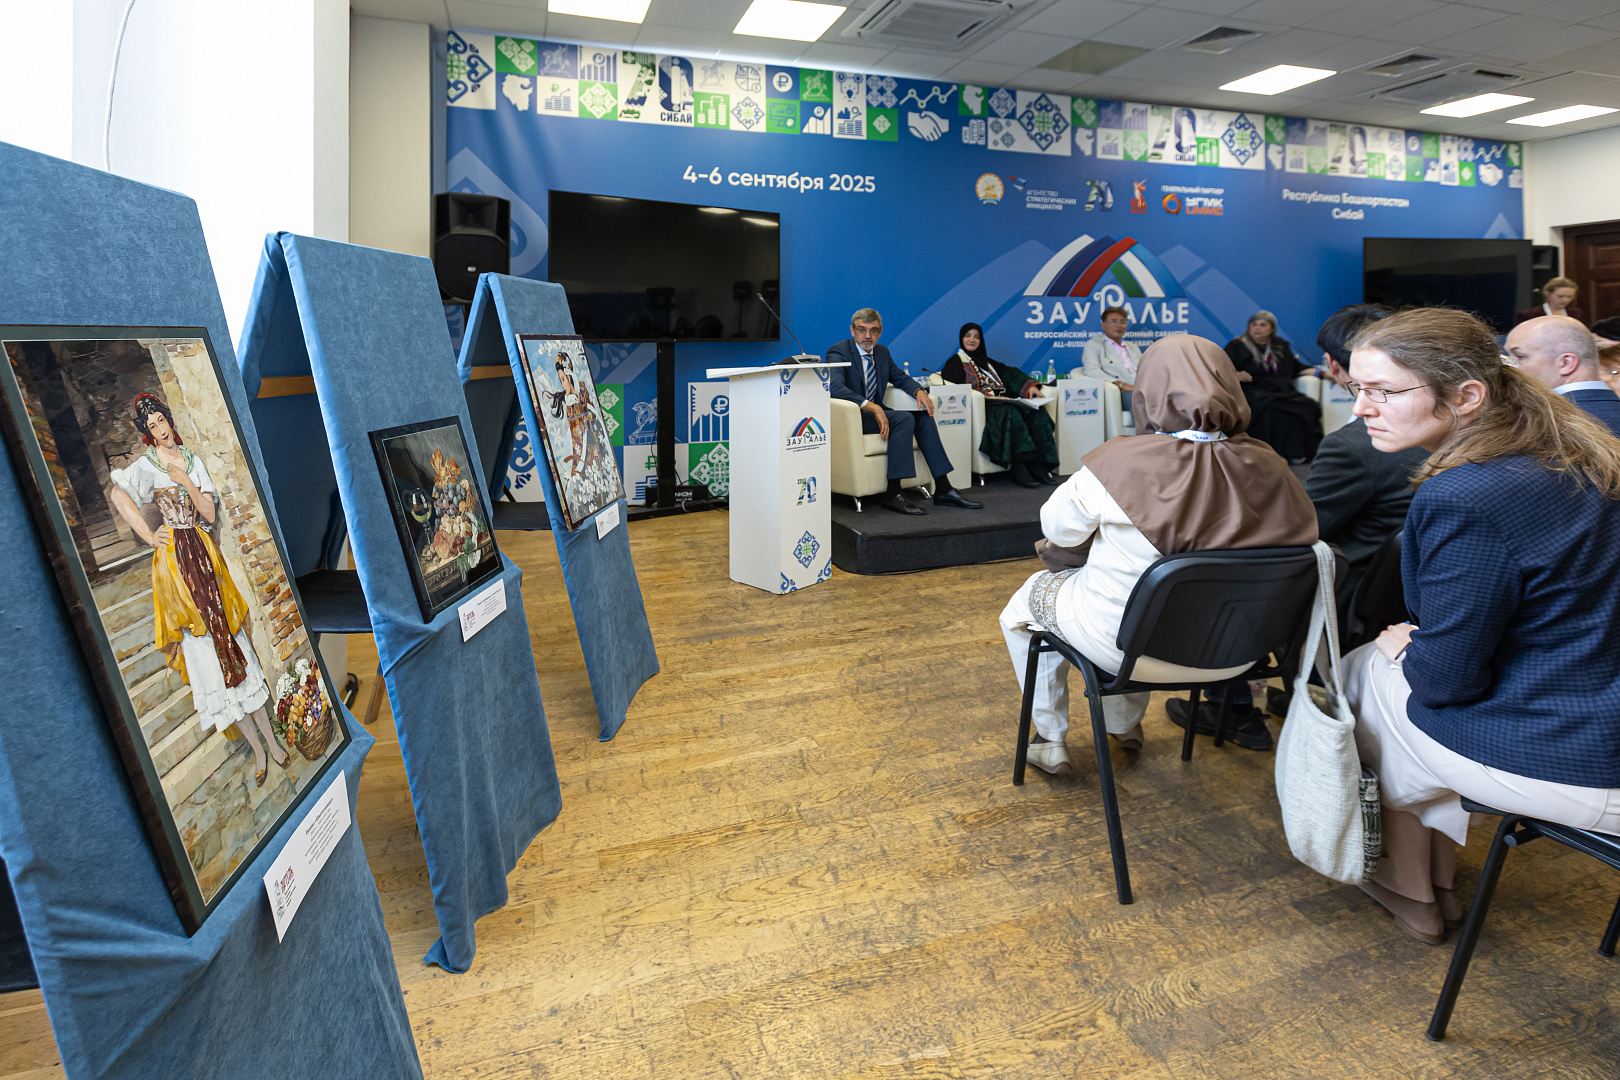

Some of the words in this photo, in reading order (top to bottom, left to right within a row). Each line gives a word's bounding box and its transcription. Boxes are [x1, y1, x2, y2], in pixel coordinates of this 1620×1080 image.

[660, 112, 693, 124] СИБАЙ
[727, 172, 824, 194] сентября
[829, 174, 876, 193] 2025
[1026, 196, 1077, 204] СТРАТЕГИЧЕСКИХ
[1185, 197, 1224, 207] УГМК
[1282, 188, 1340, 204] Республика
[1341, 192, 1410, 208] Башкортостан
[1026, 202, 1064, 210] ИНИЦИАТИВ
[1186, 206, 1224, 216] UMMC
[1332, 208, 1364, 220] Сибай
[1024, 330, 1088, 338] ВСЕРОССИЙСКИЙ
[786, 432, 826, 446] ЗАУРАЛЬЕ
